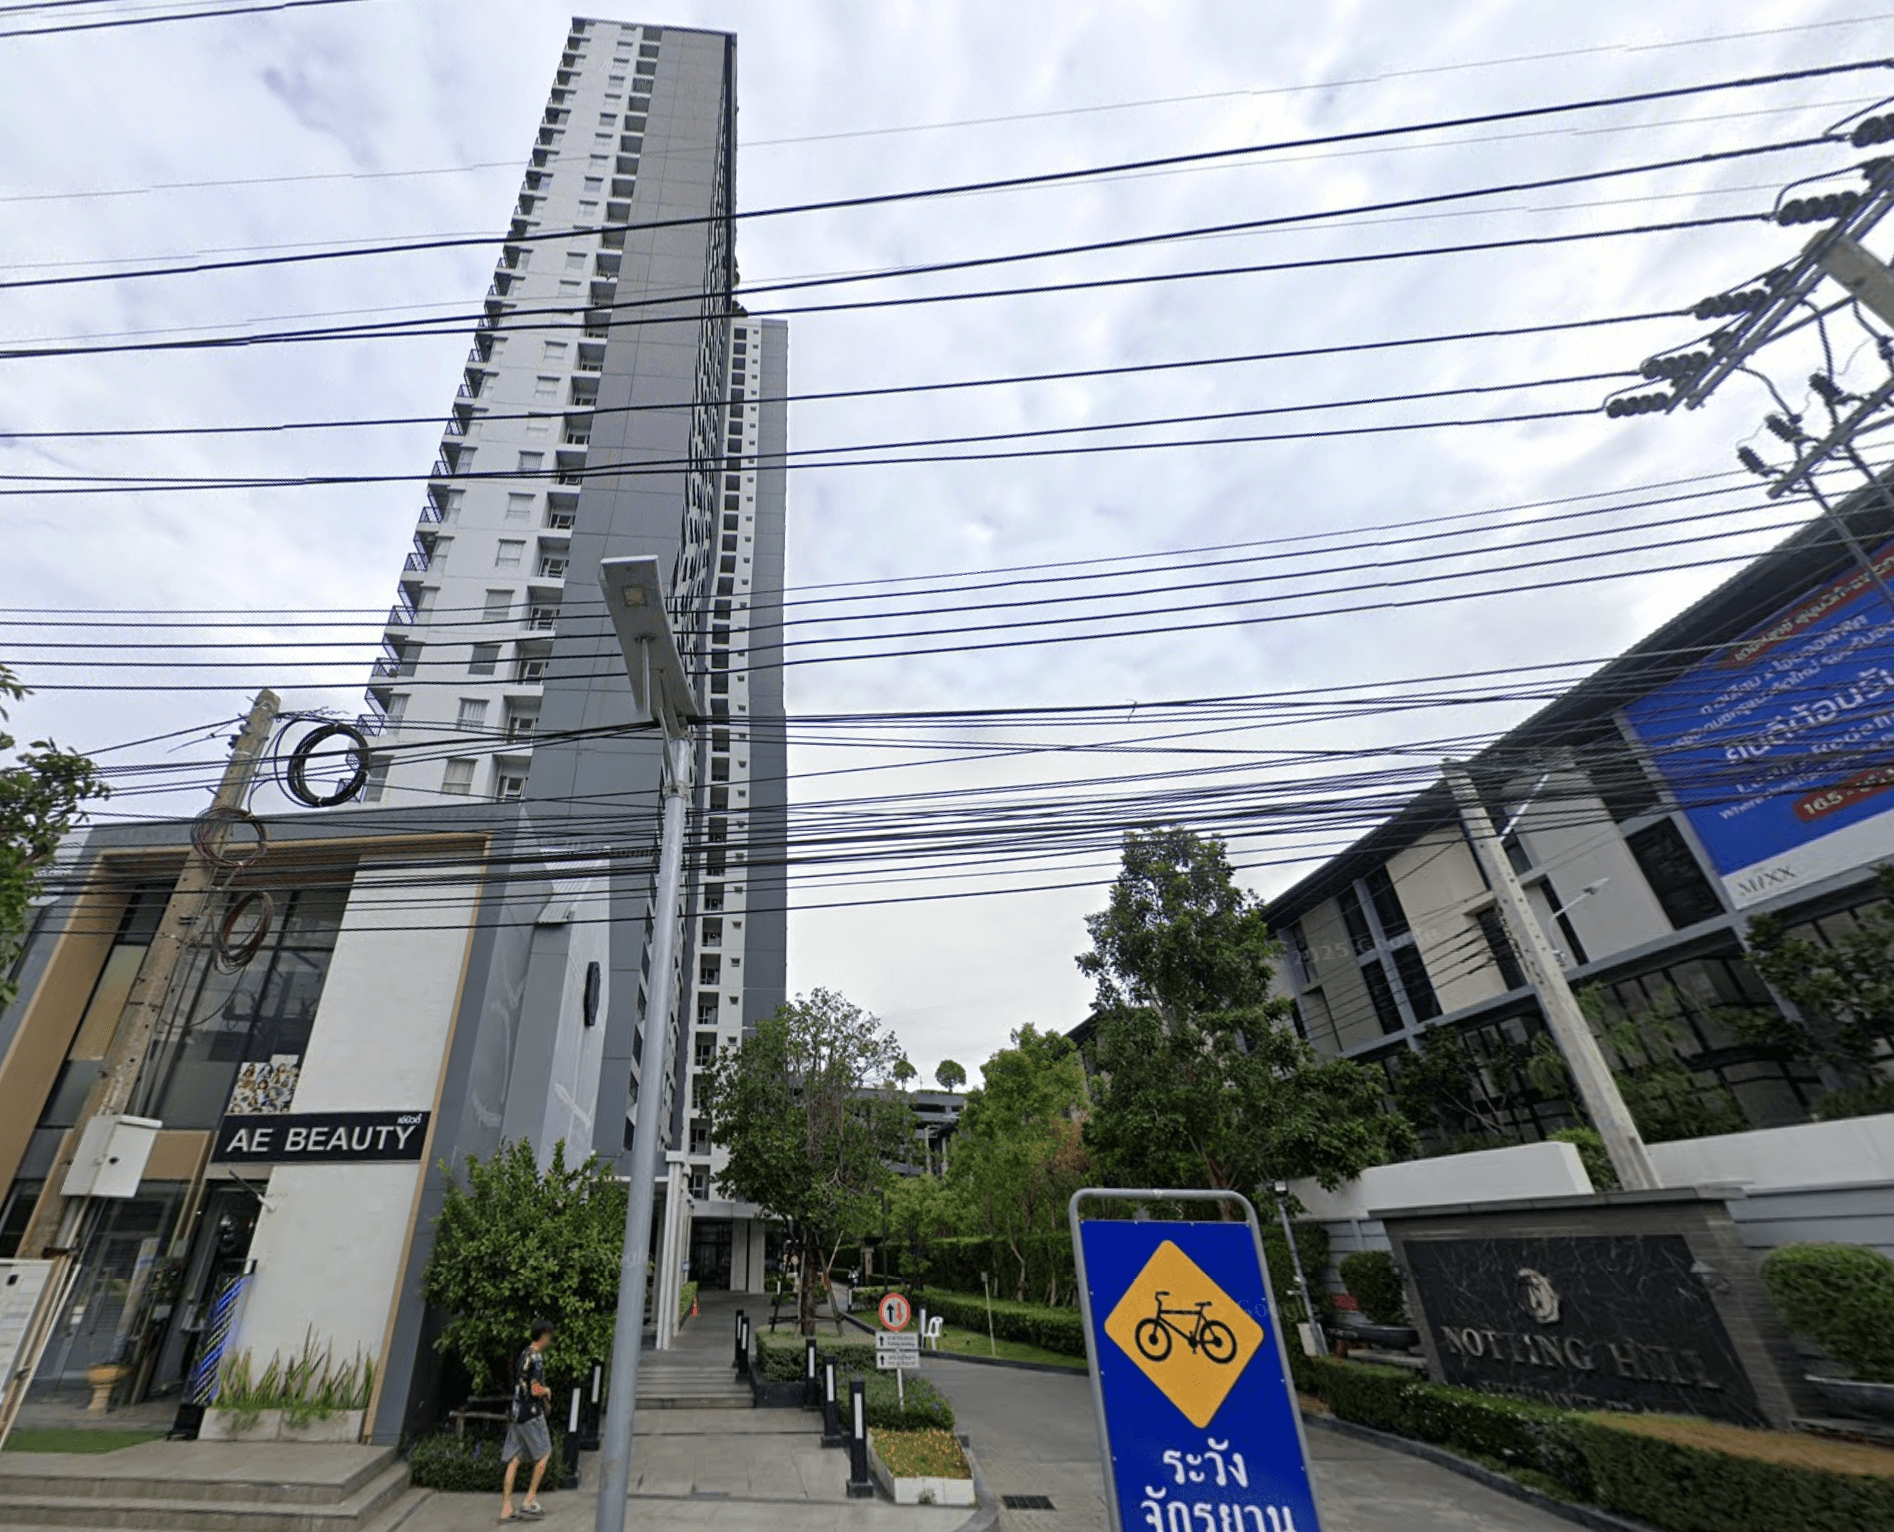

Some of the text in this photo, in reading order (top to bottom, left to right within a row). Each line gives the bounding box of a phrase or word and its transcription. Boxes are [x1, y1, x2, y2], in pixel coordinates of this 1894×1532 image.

[226, 1125, 416, 1153] AE BEAUTY
[1162, 1437, 1249, 1488] ระวัง
[1140, 1485, 1297, 1532] จักรยาน
